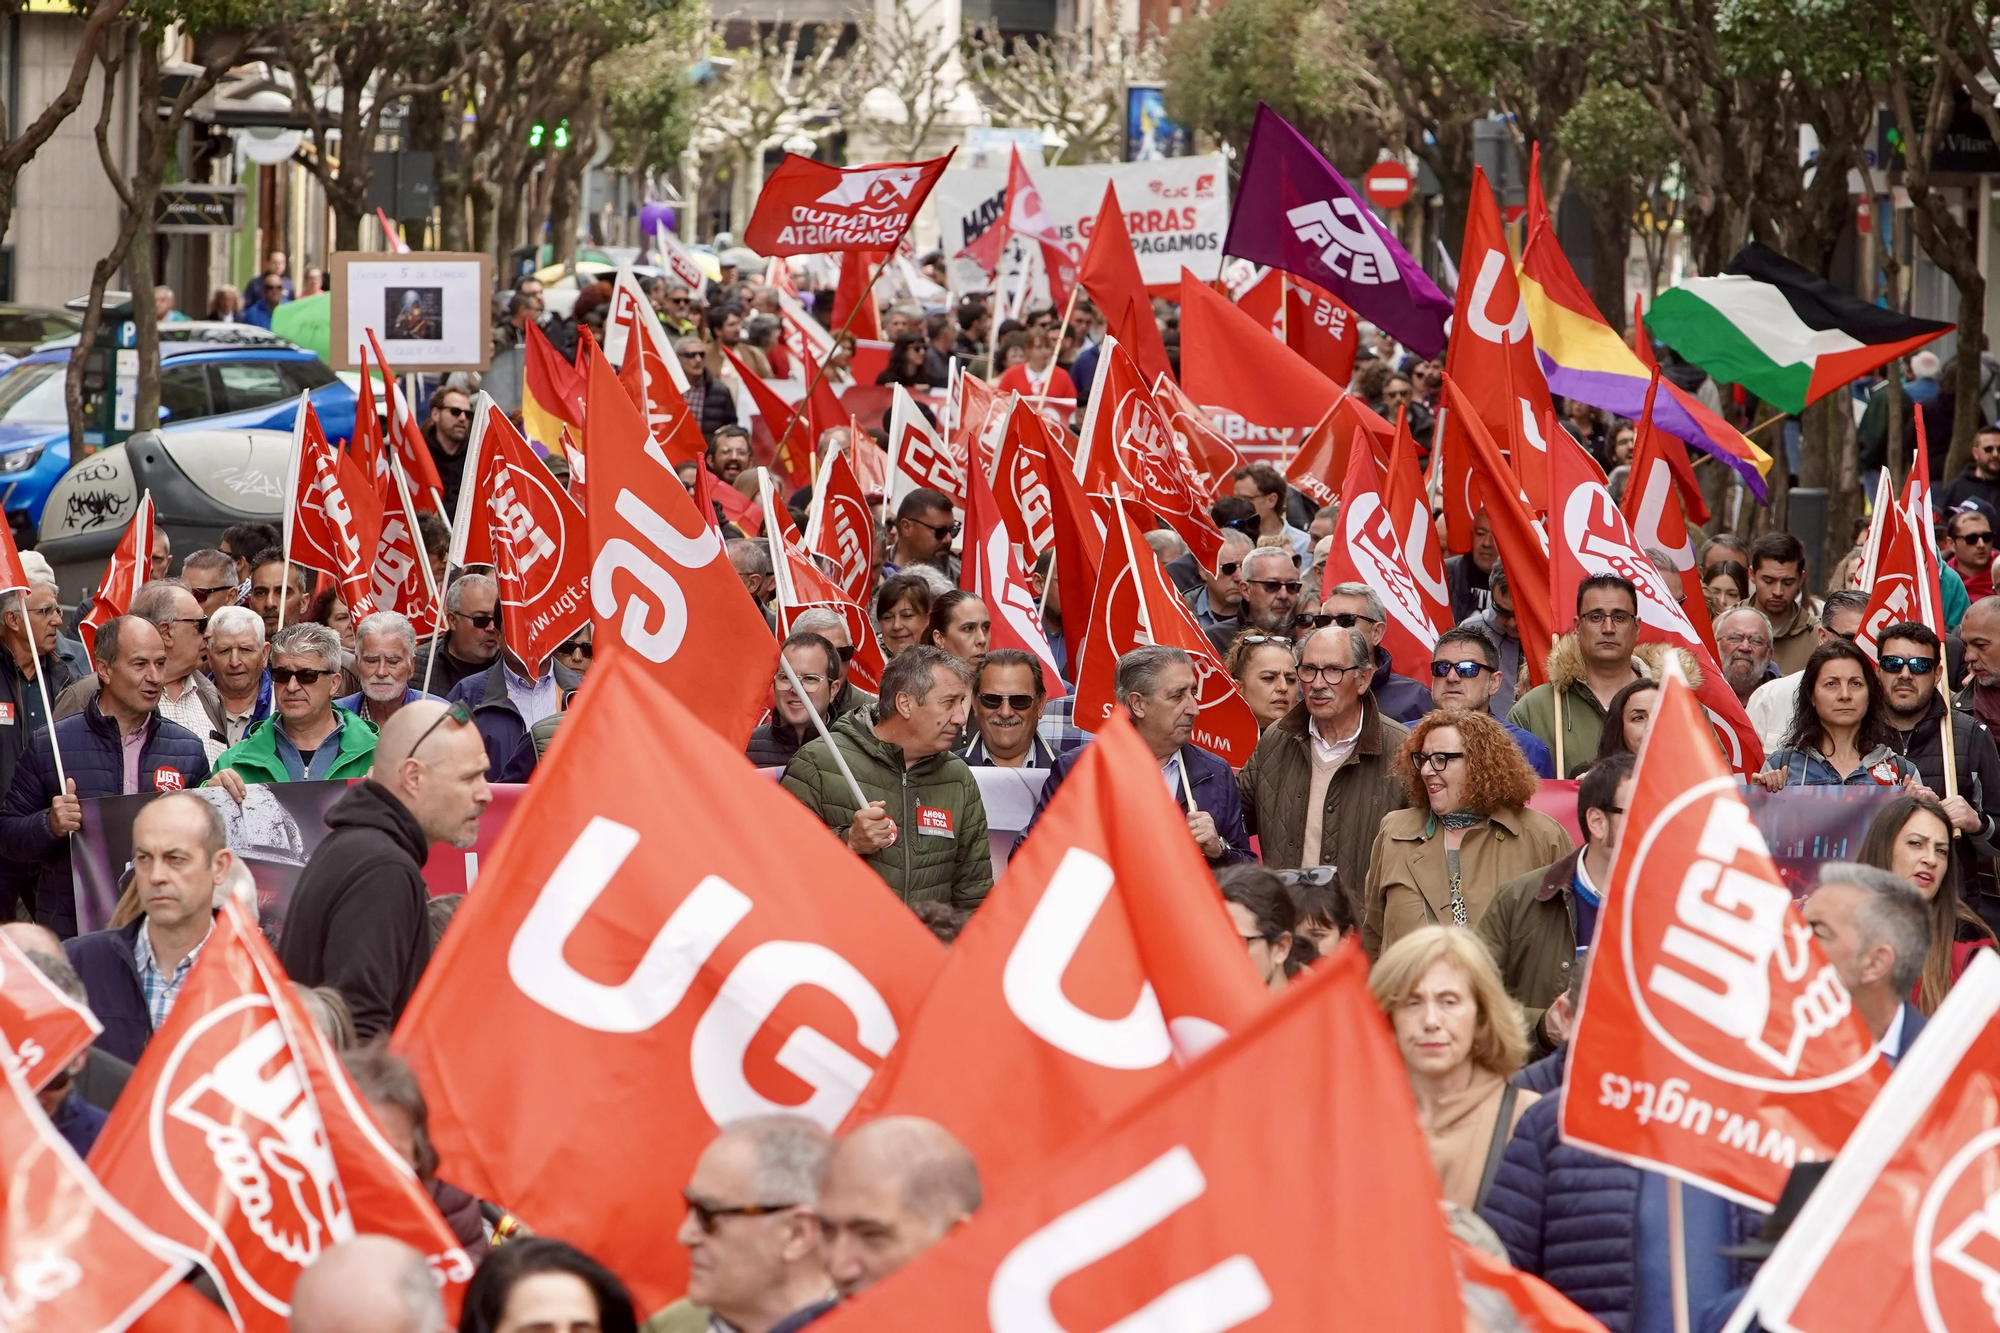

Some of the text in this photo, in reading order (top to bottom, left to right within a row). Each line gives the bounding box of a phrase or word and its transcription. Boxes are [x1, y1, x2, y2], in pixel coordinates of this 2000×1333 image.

[400, 268, 408, 279] 5
[1294, 222, 1380, 285] PCE
[122, 320, 137, 347] P
[156, 769, 181, 784] UGT
[923, 818, 948, 828] TE TOCA
[1648, 800, 1795, 1039] UGT
[508, 816, 899, 1133] UG
[1597, 1071, 1817, 1170] ww.ugt.es
